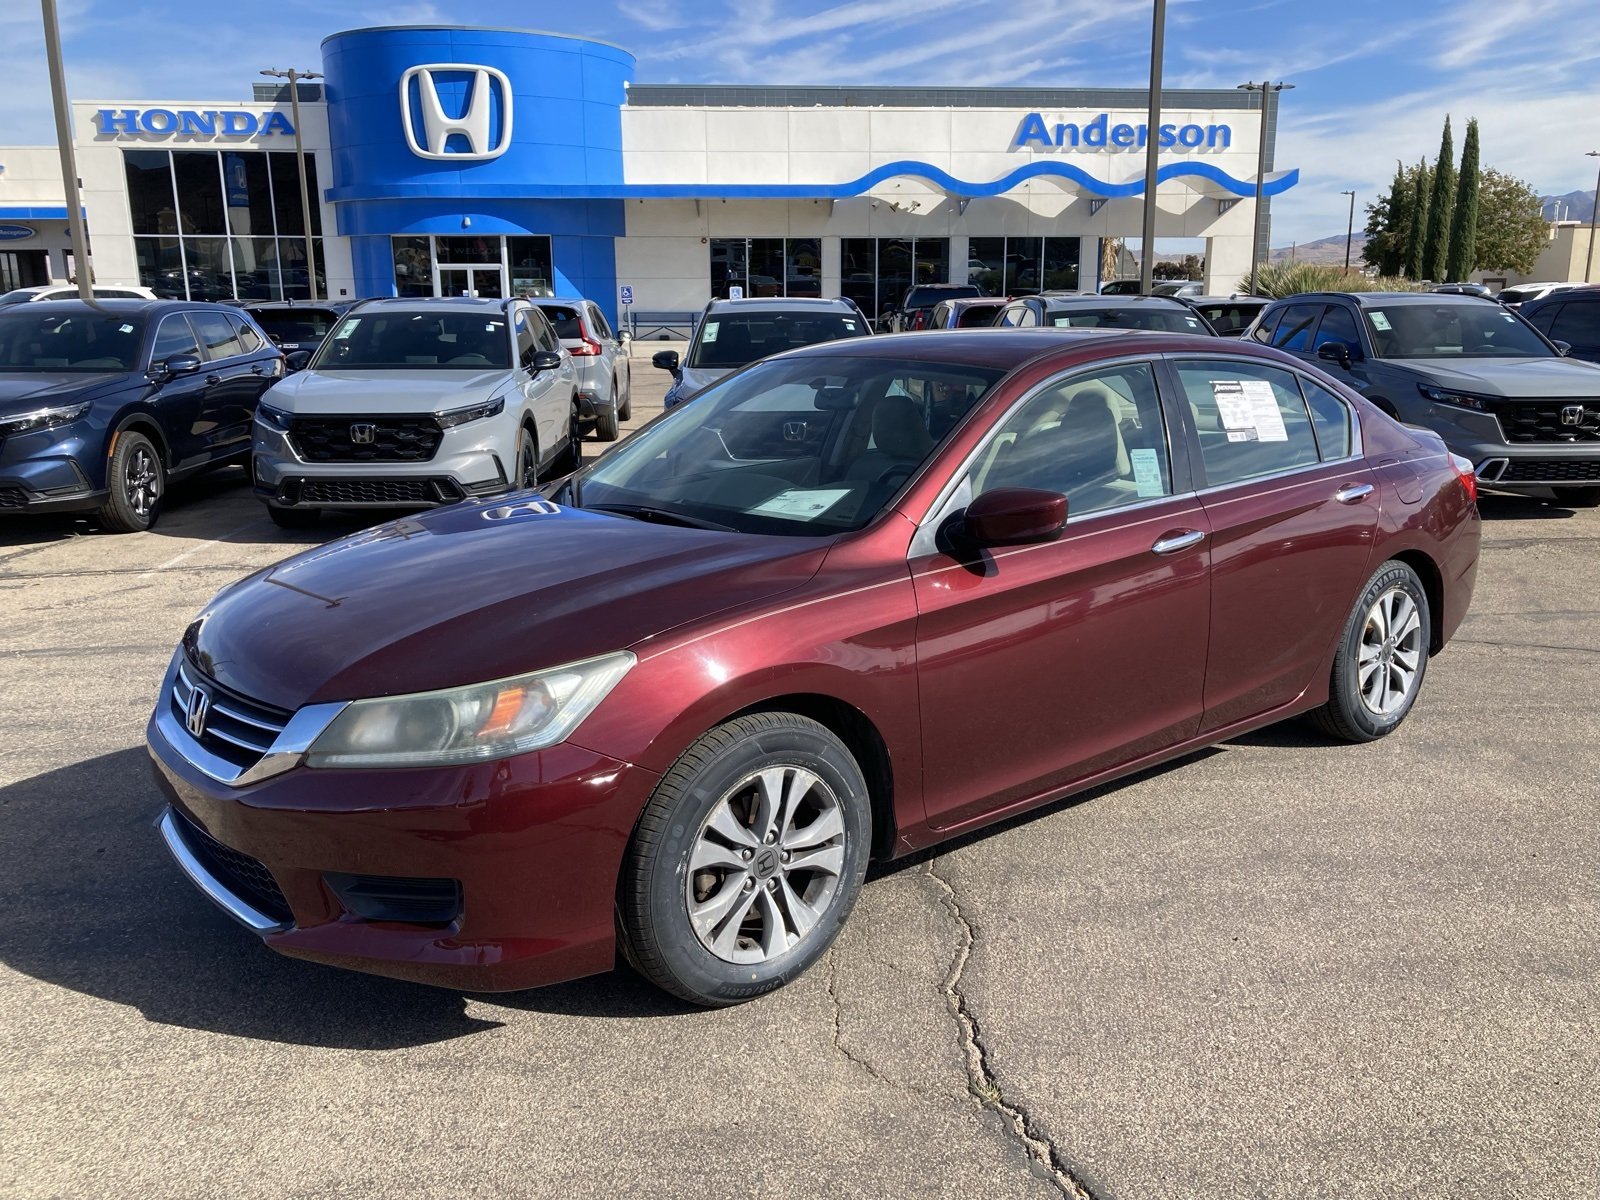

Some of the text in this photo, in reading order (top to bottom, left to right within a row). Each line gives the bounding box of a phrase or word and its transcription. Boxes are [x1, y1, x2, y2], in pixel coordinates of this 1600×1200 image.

[98, 109, 296, 135] HONDA
[1016, 113, 1232, 147] Anderson
[1366, 569, 1408, 603] ADVANTA
